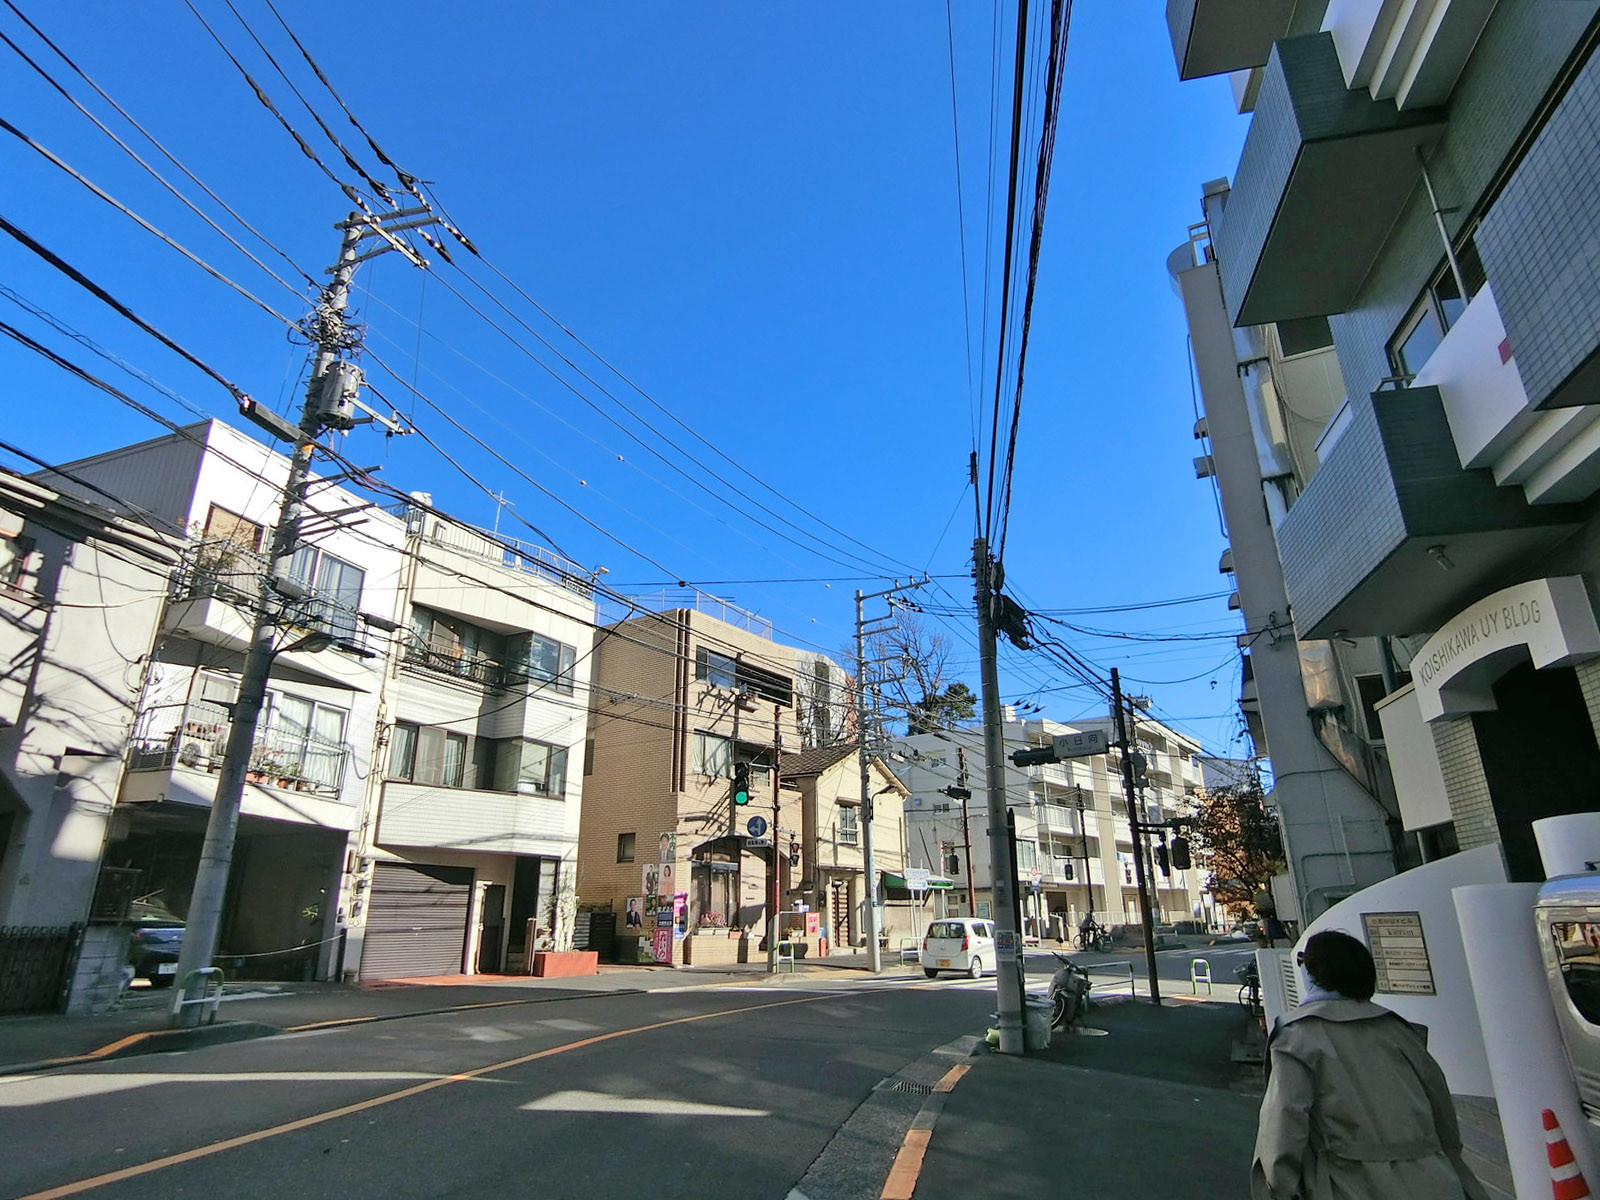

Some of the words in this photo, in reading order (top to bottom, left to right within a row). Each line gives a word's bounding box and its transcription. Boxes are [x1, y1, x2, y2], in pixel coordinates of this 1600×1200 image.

[1419, 623, 1480, 686] KOISHIKAWA
[1480, 611, 1498, 638] UY
[1502, 600, 1541, 630] BLDG
[1059, 734, 1098, 747] 小日向
